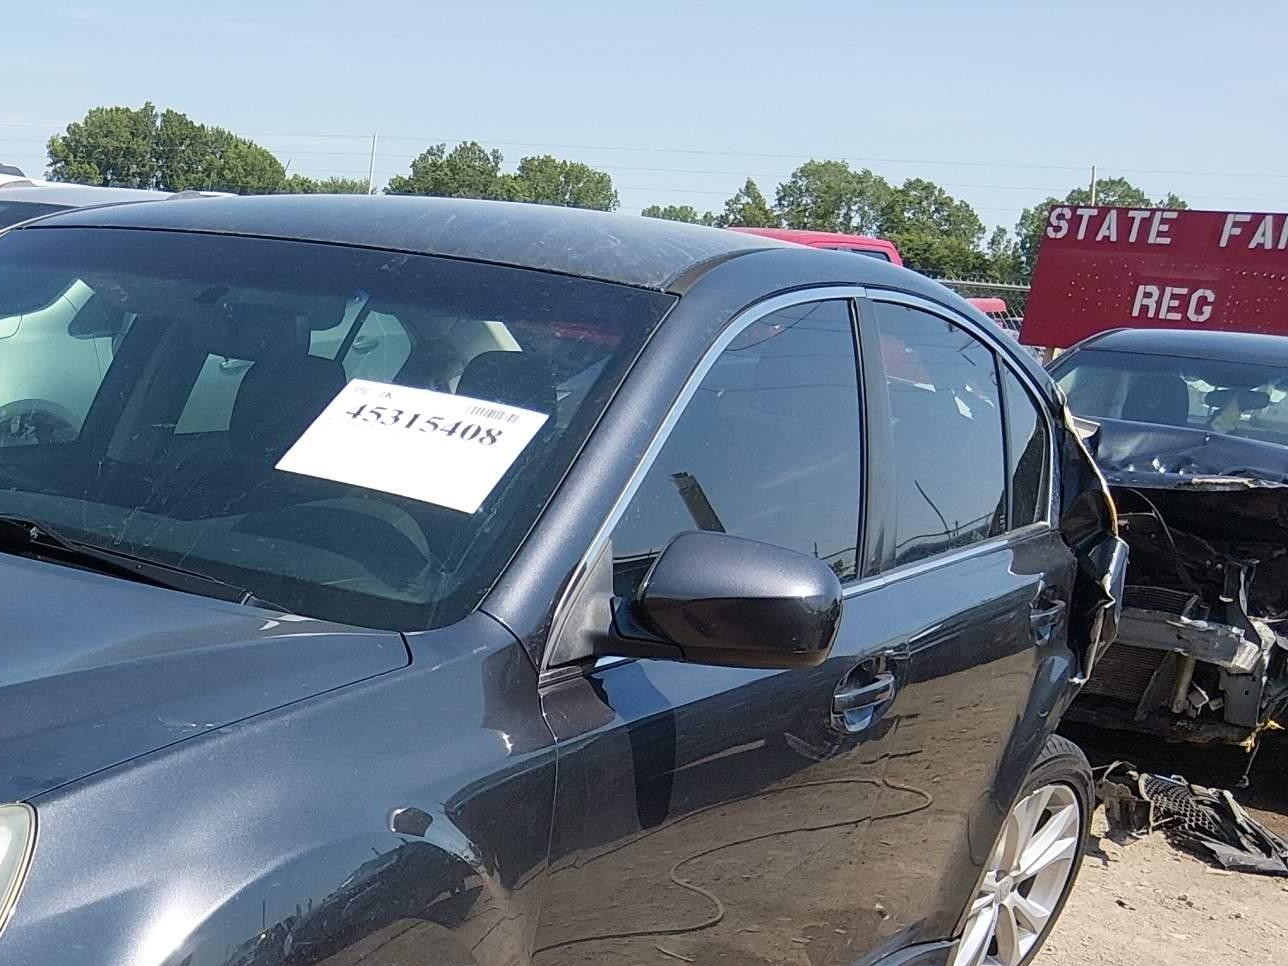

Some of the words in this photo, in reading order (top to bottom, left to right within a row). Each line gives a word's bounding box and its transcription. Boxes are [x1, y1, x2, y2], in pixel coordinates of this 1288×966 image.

[1046, 207, 1179, 245] STATE
[1131, 284, 1216, 323] REG
[345, 404, 503, 446] 45315408
